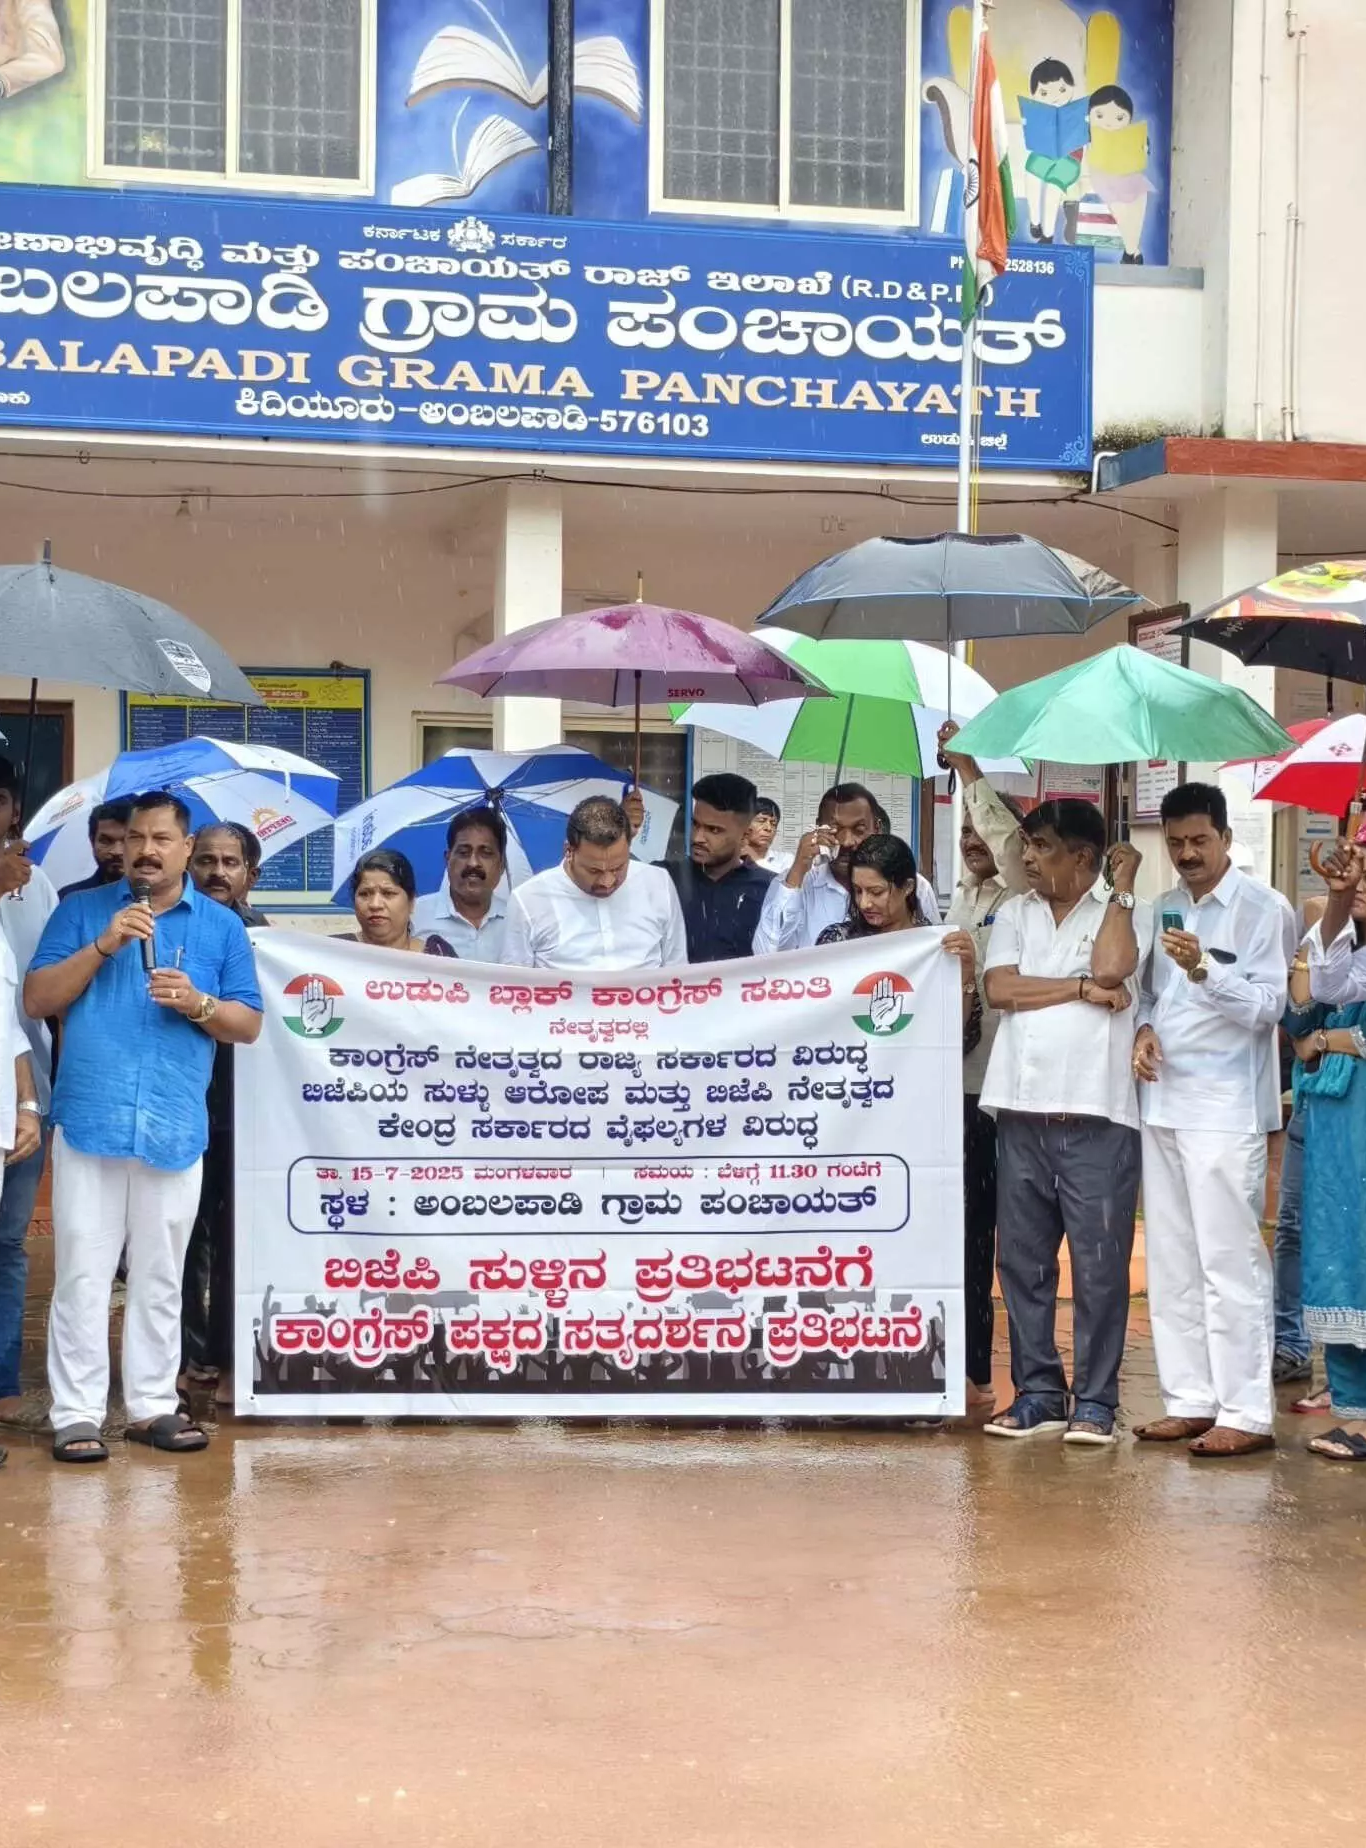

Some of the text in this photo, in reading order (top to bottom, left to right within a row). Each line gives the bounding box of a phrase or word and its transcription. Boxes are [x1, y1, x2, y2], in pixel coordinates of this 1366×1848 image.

[362, 224, 567, 249] ಕರ್ನಾಟಕ ಸರ್ಕಾರ
[221, 241, 320, 274] ಮತ್ತು
[338, 248, 571, 280] ಪಂಚಾಯತ್
[583, 263, 691, 290] ರಾಜ್
[706, 269, 832, 297] ಇಲಾಖೆ
[841, 274, 995, 307] (R.D&P.)
[358, 281, 579, 353] ಗ್ರಾಮ
[607, 287, 1067, 366] ಪಂಚಾಯತ್
[337, 351, 594, 398] GRAMA
[620, 368, 1042, 419] PANCHAYATH
[921, 432, 974, 447] ಉಡು
[667, 688, 705, 698] SERVO
[365, 975, 832, 1014] ಉಡುಪಿ ಬ್ಲಾಕ್ ಕಾಂಗ್ರೆಸ್ ಸಮಿತಿ
[549, 1016, 649, 1043] ನೇತೃತ್ವದಲ್ಲಿ
[329, 1040, 868, 1078] ಕಾಂಗ್ರೆಸ್ ನೇತೃತ್ವದ ರಾಜ್ಯ ಸರ್ಕಾರದ ವಿರುದ್ಧ
[302, 1076, 894, 1112] ಬಿಜೆಪಿಯ ಸುಳ್ಳು ಆರೋಪ ಮತ್ತು ಬಿಜೆಪಿ ನೇತೃತ್ವದ
[378, 1111, 819, 1150] ಕೇಂದ್ರ ಸರ್ಕಾರದ ವೈಫಲ್ಯಗಳ ವಿರುದ್ಧ
[316, 1165, 573, 1181] ತಾ. 15-7-2025 ಮಂಗಳವಾರ
[633, 1164, 694, 1179] ಸಮಯ
[770, 1164, 818, 1178] 11.30
[827, 1160, 882, 1178] ಗಂಟೆಗೆ
[320, 1188, 370, 1230] ಸ್ಥಳ
[414, 1190, 583, 1216] ಅಂಬಲಪಾಡಿ
[601, 1187, 682, 1225] ಗ್ರಾಮ
[700, 1185, 877, 1215] ಪಂಚಾಯತ್
[325, 1245, 874, 1309] ಬಿಜೆಪಿ ಸುಳ್ಳಿನ ಪ್ರತಿಭಟನೆಗೆ
[275, 1305, 923, 1369] ಕಾಂಗ್ರೆಸ್ ಪಕ್ಷದ ಸತ್ಯದರ್ಶನ ಪ್ರತಿಭಟನೆ
